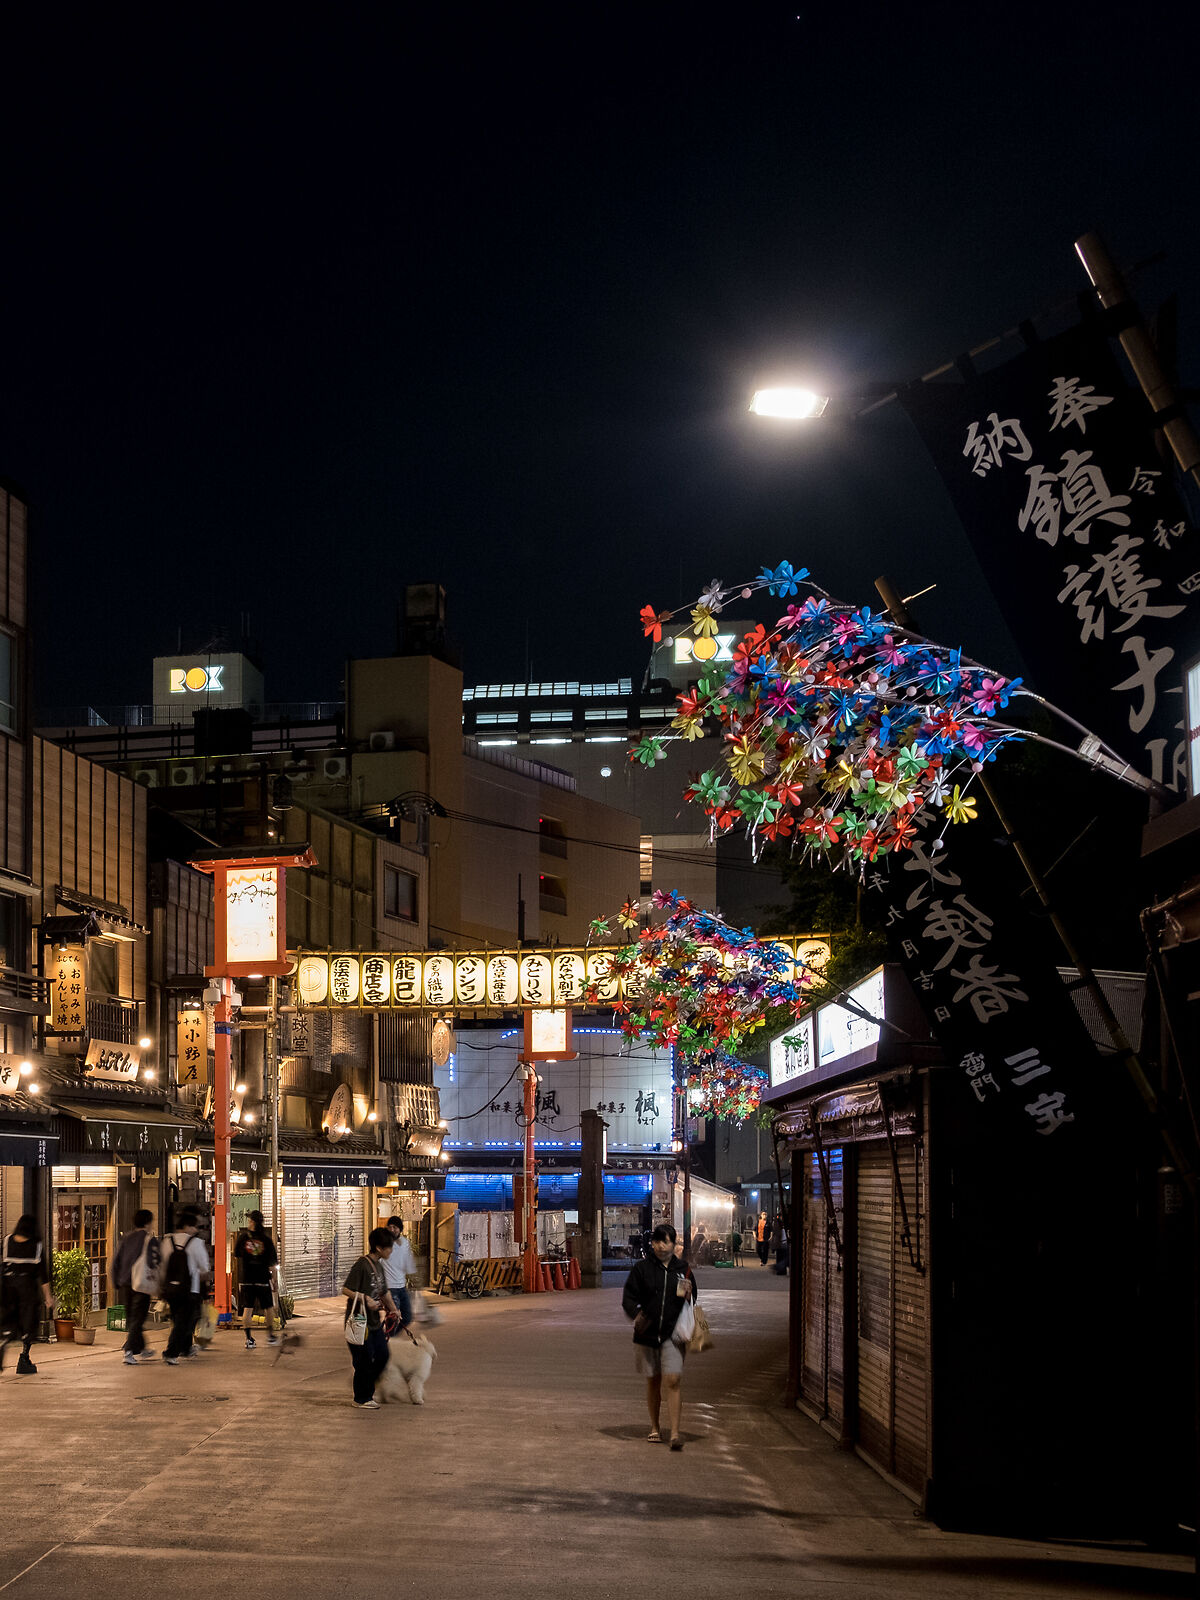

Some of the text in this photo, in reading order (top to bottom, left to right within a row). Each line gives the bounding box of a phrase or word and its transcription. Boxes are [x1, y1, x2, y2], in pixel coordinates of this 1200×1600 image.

[675, 635, 735, 664] ROX
[170, 666, 224, 693] ROX
[57, 969, 68, 1026] もんじゃ焼
[70, 969, 81, 1025] お好み焼
[364, 958, 384, 1001] 商店会
[427, 958, 444, 1002] きもの織伝
[457, 958, 478, 1001] パッション
[491, 959, 506, 1001] 浅草苺座
[524, 958, 543, 1001] みどりや
[558, 956, 576, 997] かなや刷子
[184, 1028, 201, 1081] 小野屋
[597, 1101, 627, 1114] 和菓子
[635, 1089, 660, 1117] 楓
